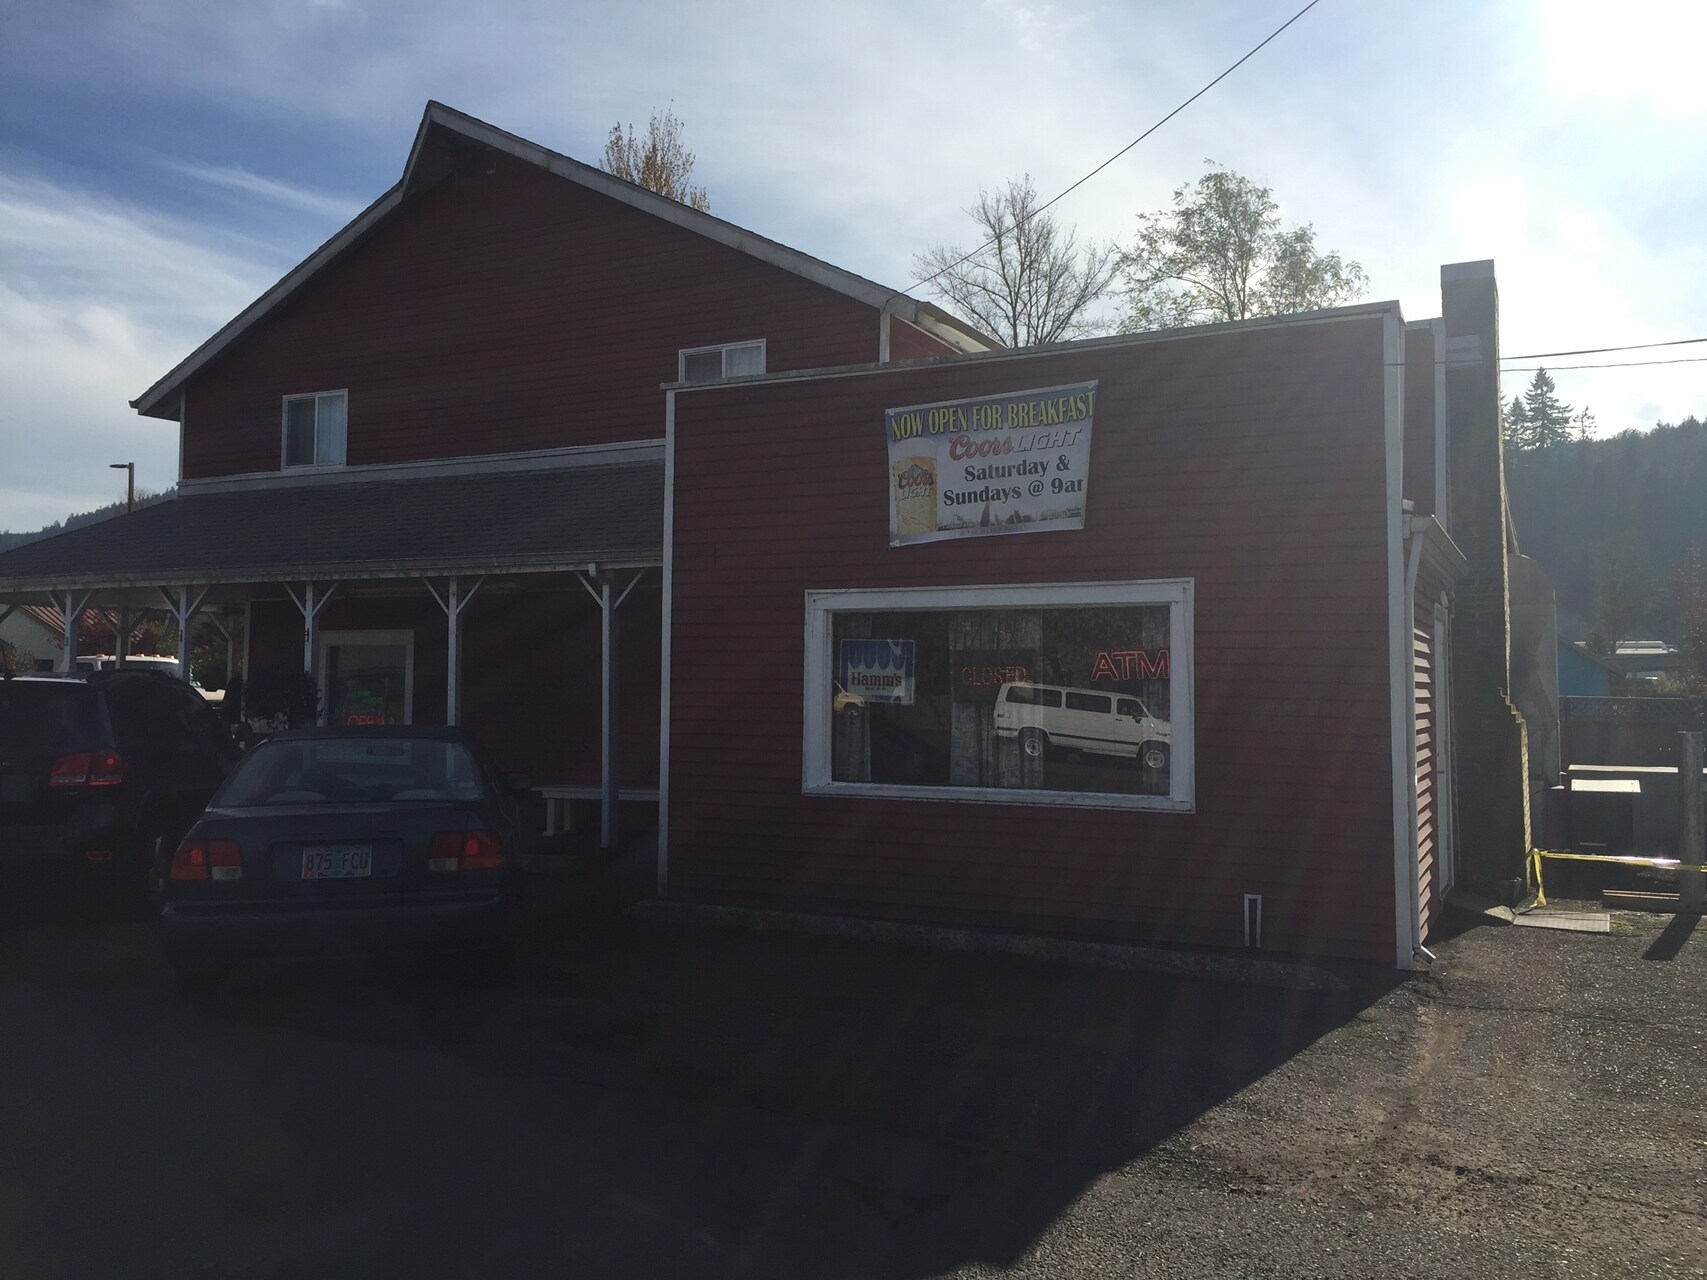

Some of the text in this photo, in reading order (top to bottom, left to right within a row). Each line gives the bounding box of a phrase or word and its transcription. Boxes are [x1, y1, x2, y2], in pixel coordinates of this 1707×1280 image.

[891, 390, 1096, 442] NOW OPEN FOR BREAKFAST
[948, 428, 1083, 461] Coors LIGHT
[964, 454, 1070, 482] Saturday &
[943, 484, 1022, 507] Sundays
[1028, 479, 1044, 496] @
[851, 671, 902, 687] Hamm's
[960, 665, 1029, 687] CLOSED
[1090, 649, 1170, 681] ATM
[305, 851, 368, 871] 875 FCU
